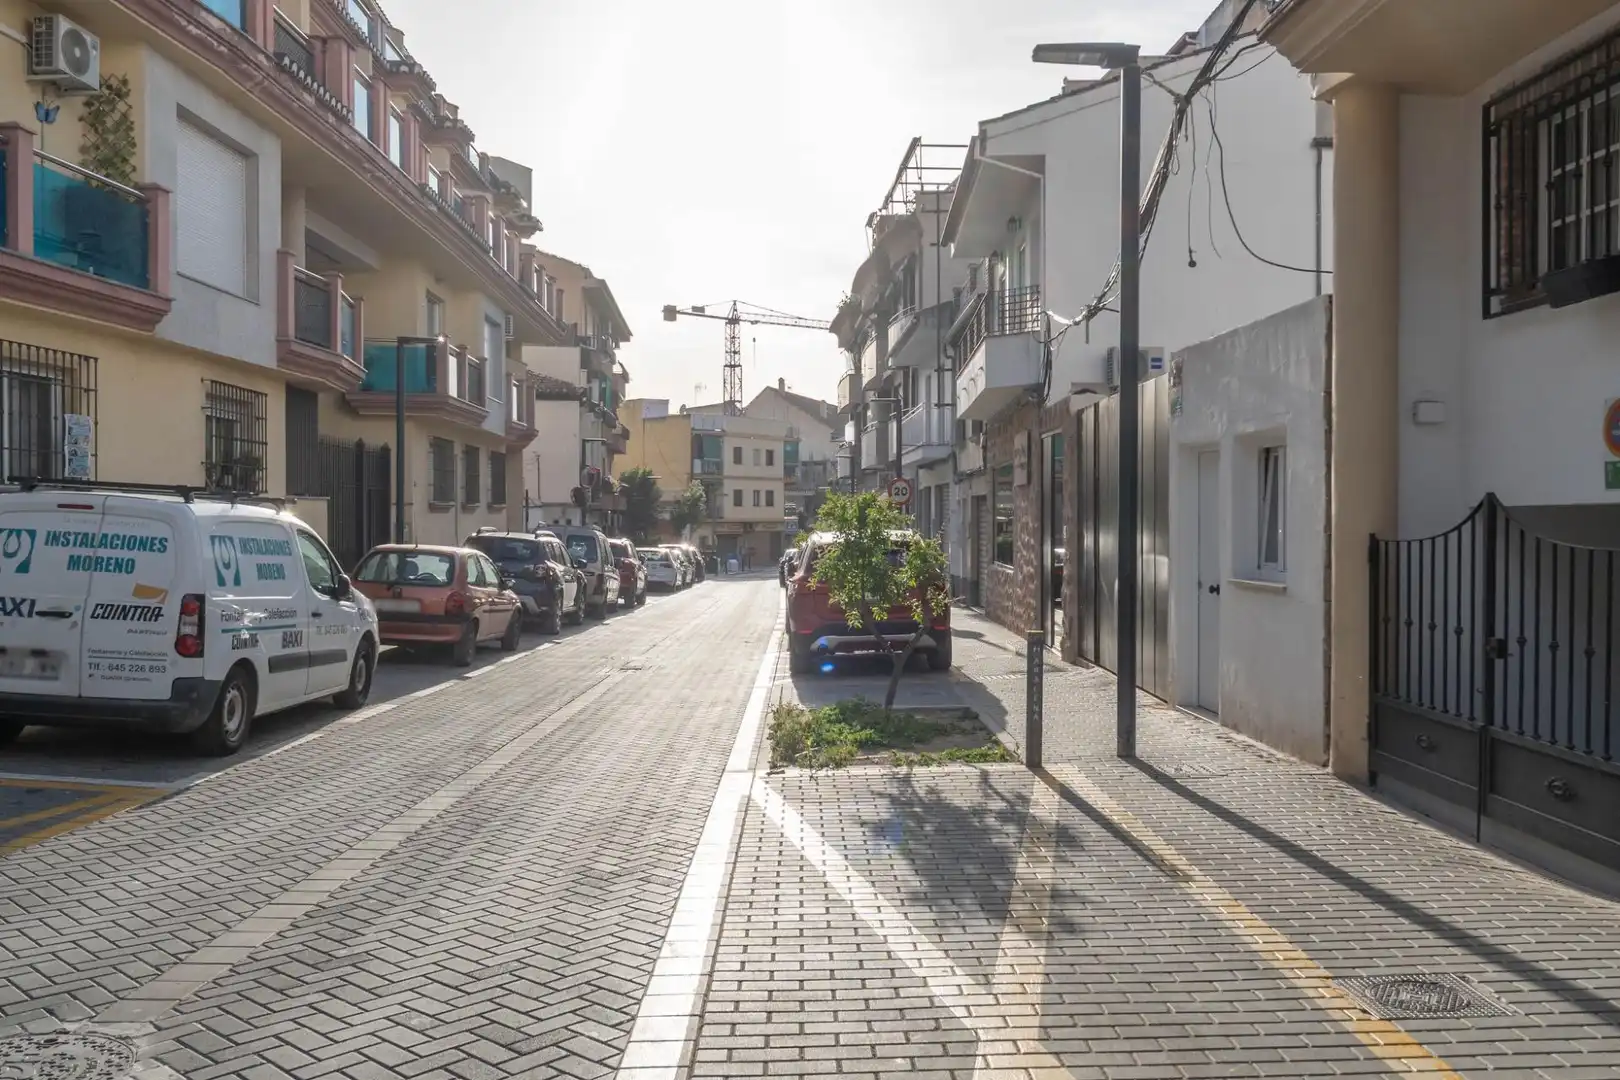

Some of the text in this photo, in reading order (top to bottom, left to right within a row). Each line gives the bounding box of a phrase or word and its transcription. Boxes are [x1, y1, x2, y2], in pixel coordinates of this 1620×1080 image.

[894, 487, 908, 496] 20
[44, 530, 168, 553] INSTALACIONES
[239, 537, 292, 556] INSTALACIONES
[67, 554, 135, 574] MORENO
[256, 563, 286, 580] MORENO
[90, 603, 164, 622] COINTRA
[282, 630, 303, 649] BAXI
[108, 663, 126, 672] 645
[128, 664, 146, 673] 226
[148, 665, 167, 674] 893
